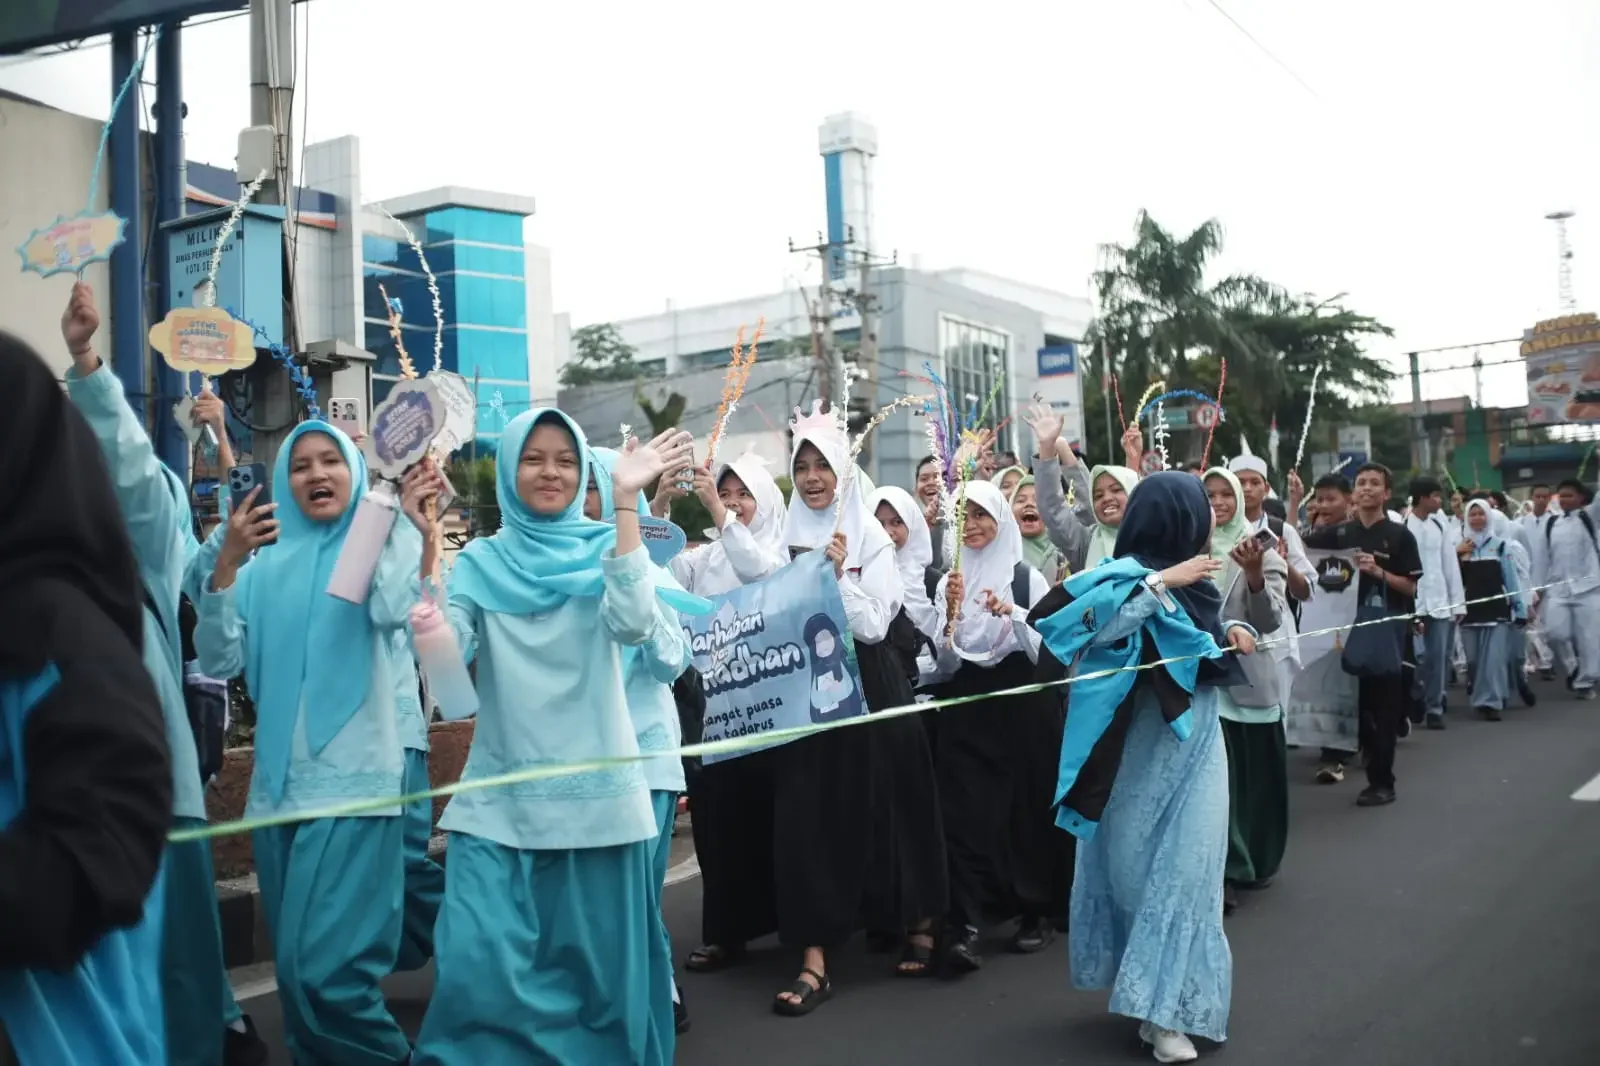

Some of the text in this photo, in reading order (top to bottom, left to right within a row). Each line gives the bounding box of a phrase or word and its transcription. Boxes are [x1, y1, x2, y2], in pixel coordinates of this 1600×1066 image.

[704, 696, 783, 726] angat puasa
[724, 718, 774, 739] tadarus
